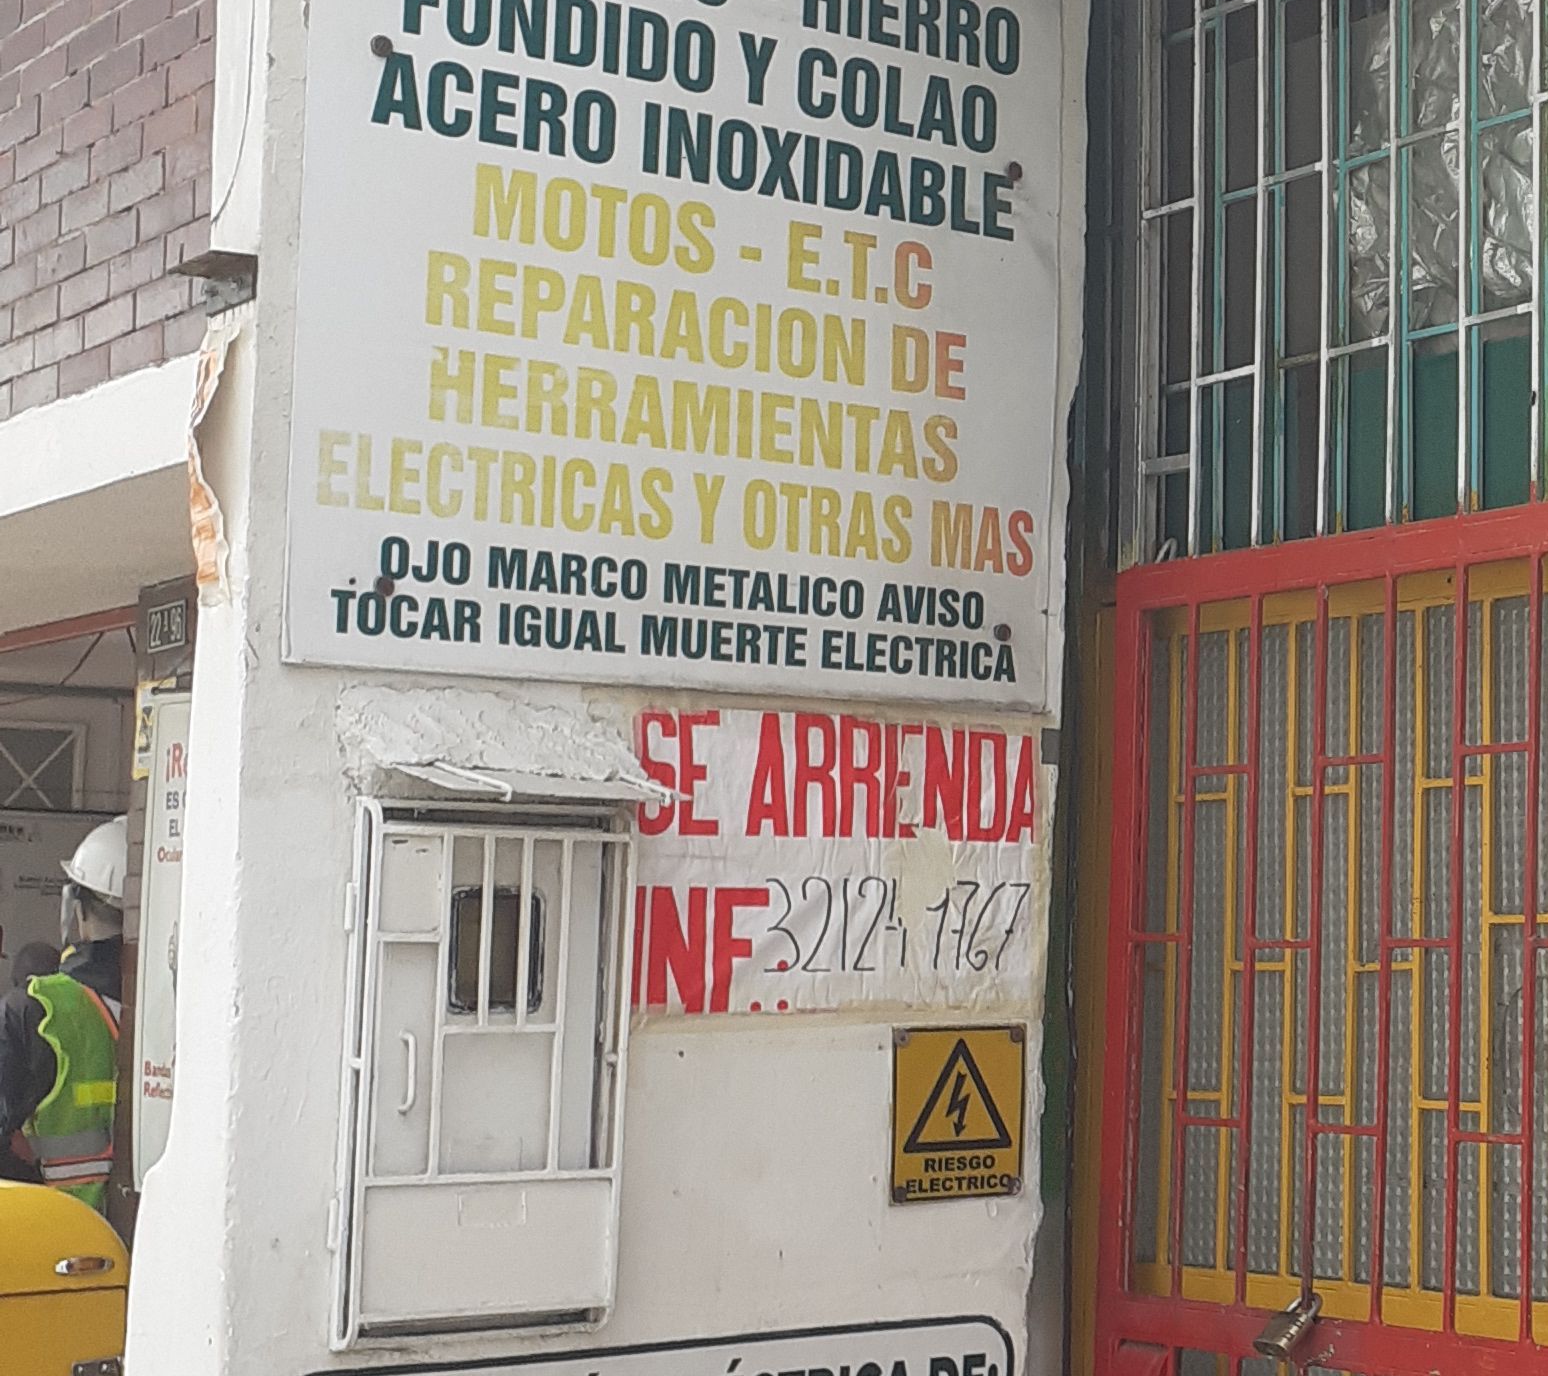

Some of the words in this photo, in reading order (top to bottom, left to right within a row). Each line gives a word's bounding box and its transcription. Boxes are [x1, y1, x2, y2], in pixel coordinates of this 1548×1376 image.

[371, 50, 618, 165] ACERO
[642, 102, 1016, 242] INOXIDABLE
[738, 32, 779, 107] Y
[800, 45, 998, 154] COLAO
[472, 162, 716, 275] MOTOS
[786, 220, 934, 310] E.T.C
[424, 250, 866, 406] REPARACION
[893, 324, 968, 400] DE
[427, 345, 959, 485] HERRAMIENTAS
[315, 429, 675, 544] ELECTRICAS
[694, 474, 727, 545] Y
[742, 479, 914, 565] OTRAS
[930, 498, 1035, 578] MAS
[331, 588, 481, 645] TOCAR
[499, 604, 626, 655] IGUAL
[641, 615, 808, 668] MUERTE
[821, 629, 1017, 684] ELECTRICA
[381, 536, 472, 587] OJO
[488, 545, 648, 603] MARCO
[663, 562, 865, 621] METALICO
[877, 584, 984, 632] AVISO
[637, 709, 721, 837] SE
[904, 1173, 1014, 1196] ELECTRICO
[923, 1155, 996, 1174] RIESGO
